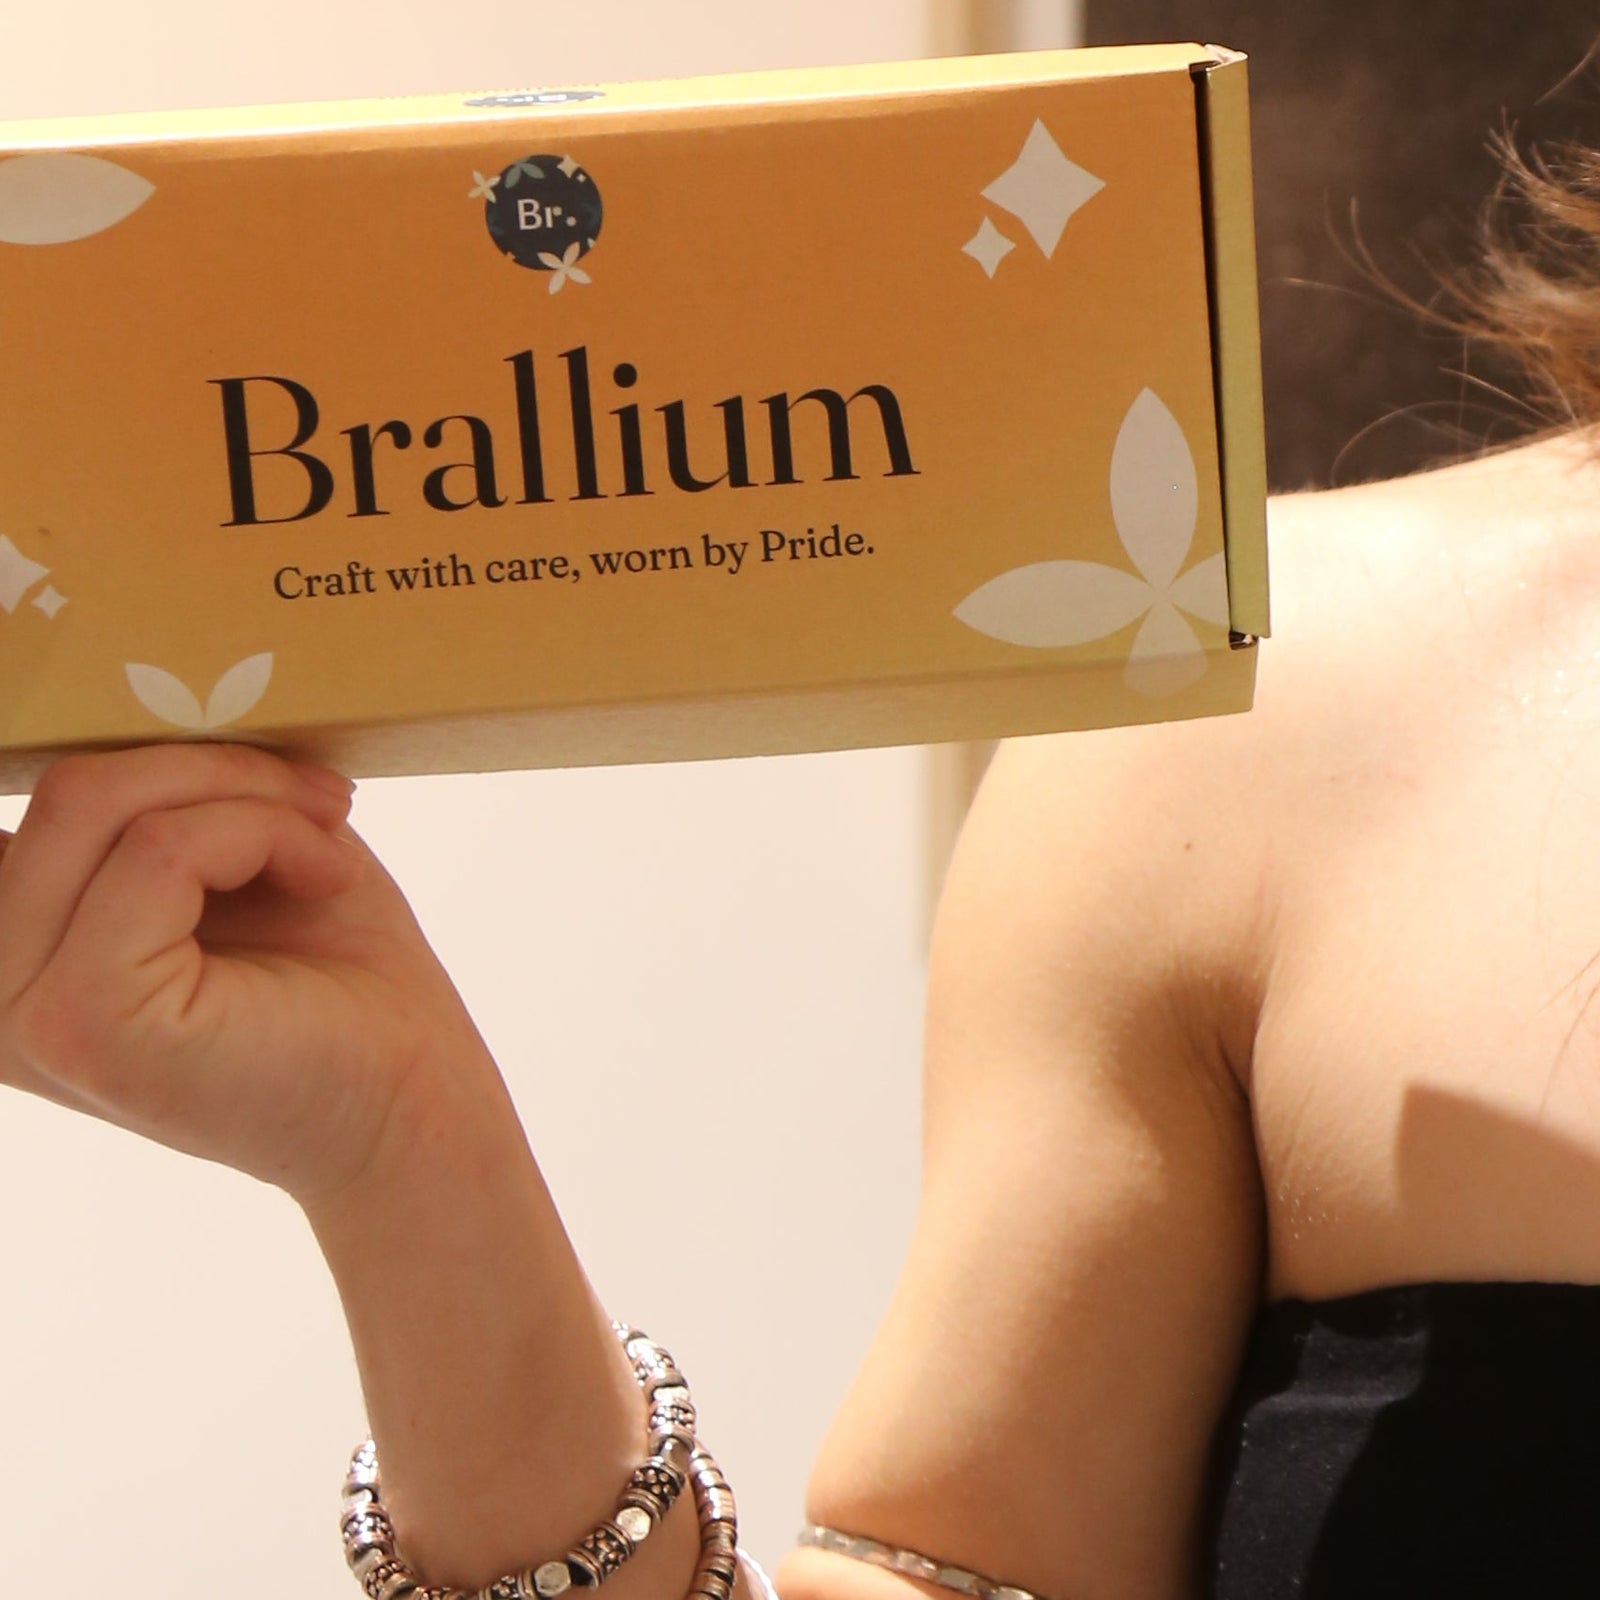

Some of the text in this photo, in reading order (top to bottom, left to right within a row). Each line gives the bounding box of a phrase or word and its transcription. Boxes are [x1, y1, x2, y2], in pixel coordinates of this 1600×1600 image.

[516, 197, 578, 231] Br.
[205, 344, 922, 529] Brallium
[273, 523, 876, 600] Craft with care, worn by Pride.
